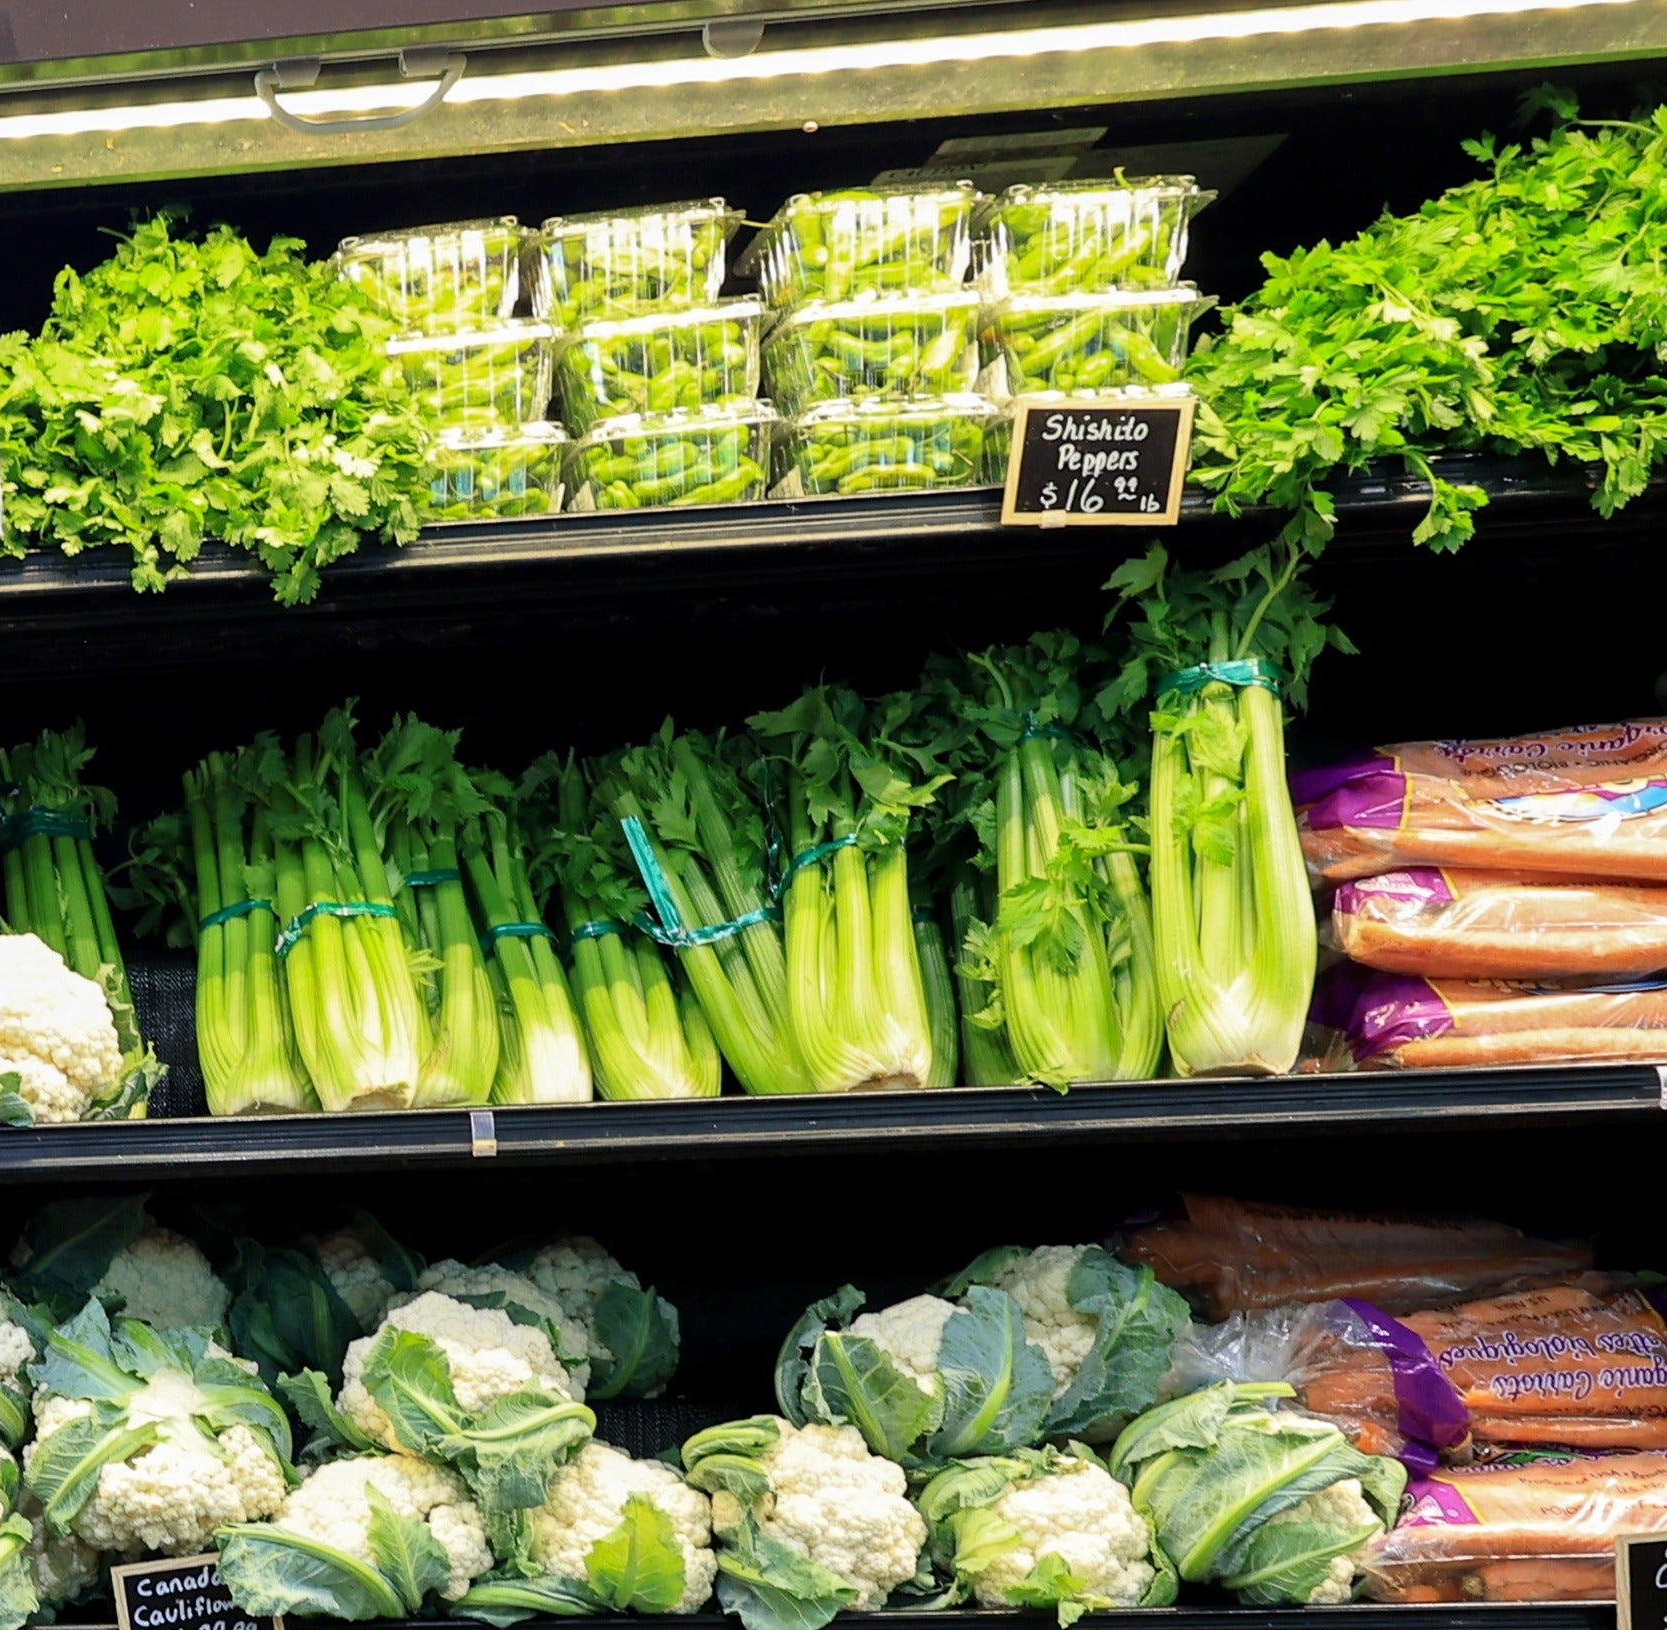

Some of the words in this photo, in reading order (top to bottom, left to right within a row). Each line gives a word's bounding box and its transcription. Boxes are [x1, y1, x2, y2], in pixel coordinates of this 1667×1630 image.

[1041, 414, 1150, 441] Shishito
[1057, 443, 1140, 478] Peppers
[1139, 493, 1161, 513] lb
[1490, 1369, 1594, 1402] Carrots
[133, 1596, 236, 1629] Cauliflow
